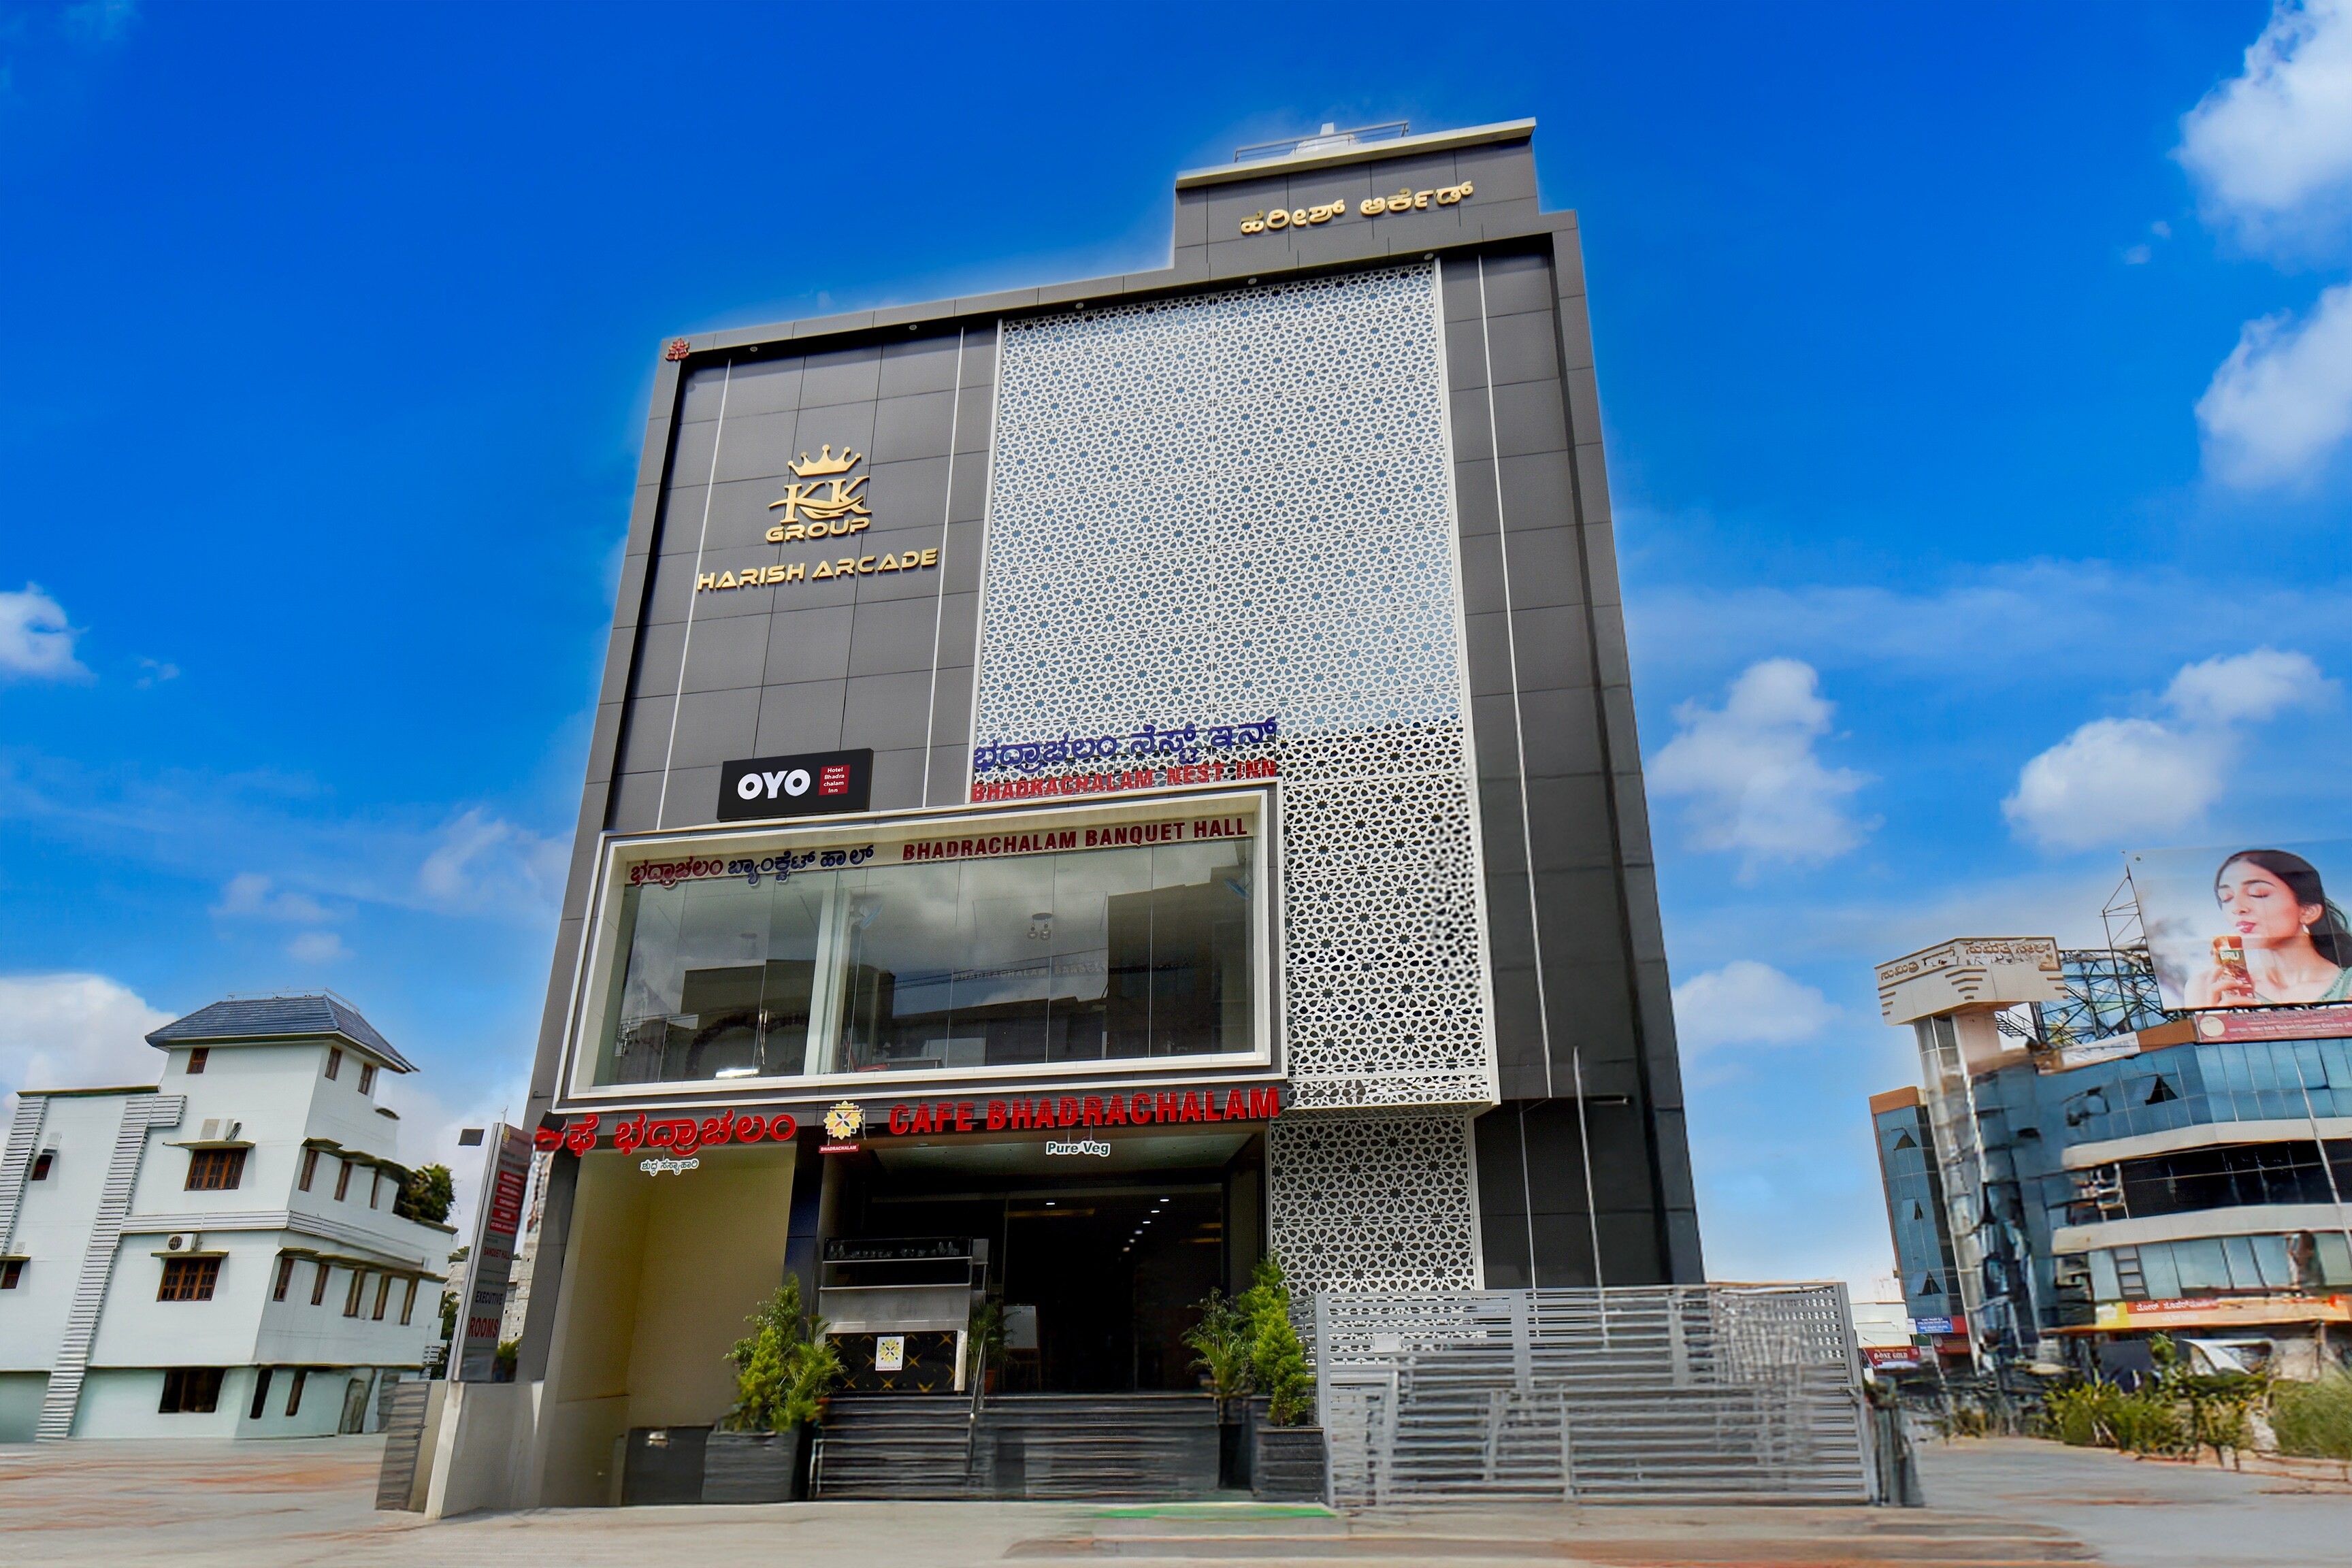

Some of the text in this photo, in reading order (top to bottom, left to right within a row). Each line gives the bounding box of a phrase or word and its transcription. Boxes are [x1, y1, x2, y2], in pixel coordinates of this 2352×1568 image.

[770, 475, 872, 524] KK
[765, 517, 870, 543] GROUP
[697, 548, 938, 591] HARISH ARCADE
[737, 768, 811, 800] OYO
[971, 760, 1277, 803] BHADRACHALAM NEST INN
[902, 817, 1248, 862] BHADRACHALAM BANQUET HALL
[888, 1086, 1280, 1136] CAFE BHADRACHALAM
[1047, 1142, 1109, 1156] Pure Veg
[475, 1290, 504, 1305] EXECUTIVE
[468, 1317, 499, 1339] ROOMS
